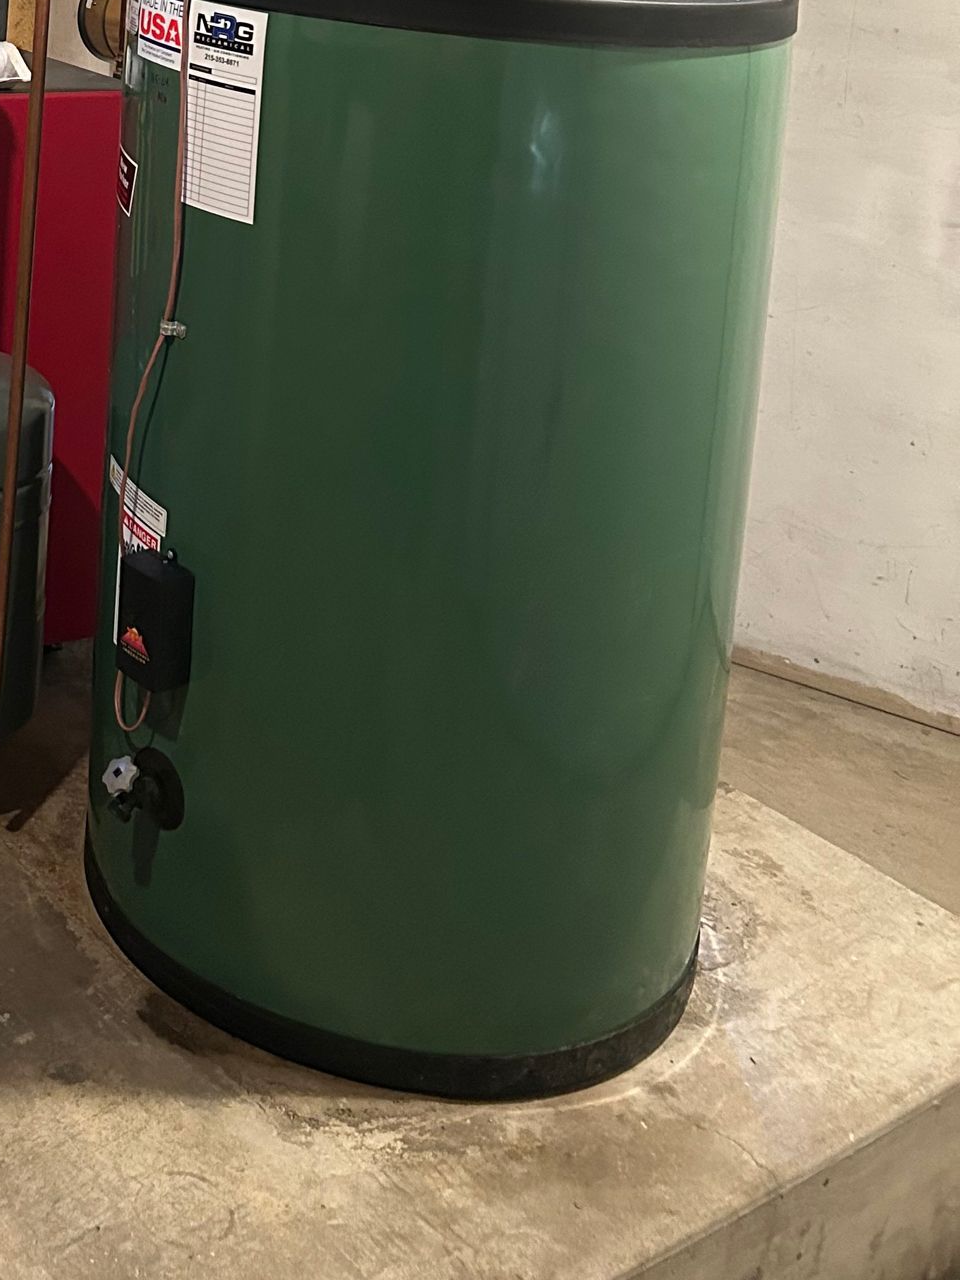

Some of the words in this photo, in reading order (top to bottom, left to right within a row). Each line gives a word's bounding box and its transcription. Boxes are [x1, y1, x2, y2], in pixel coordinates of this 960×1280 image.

[160, 0, 168, 12] IN
[168, 1, 184, 18] THE
[140, 8, 181, 47] USA
[195, 12, 255, 43] NRG
[195, 35, 252, 52] MECHANICAL
[128, 517, 158, 550] DANGER
